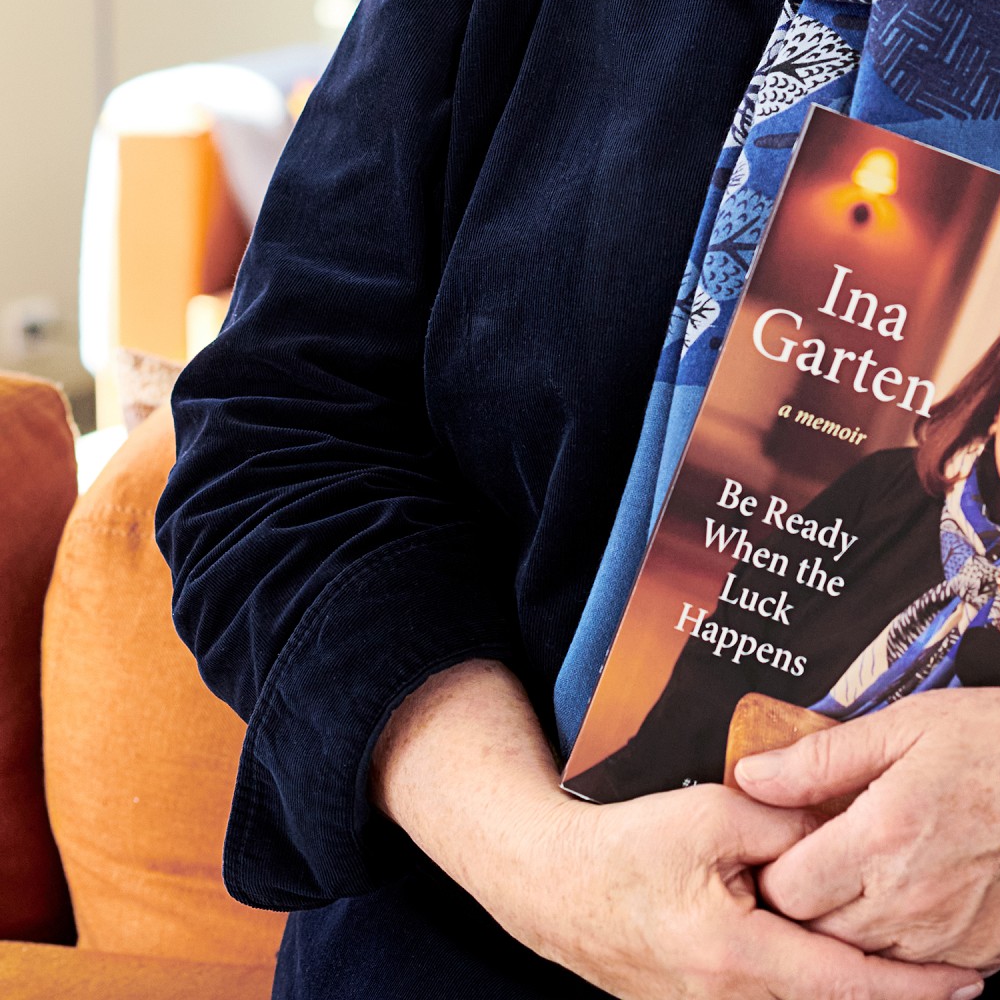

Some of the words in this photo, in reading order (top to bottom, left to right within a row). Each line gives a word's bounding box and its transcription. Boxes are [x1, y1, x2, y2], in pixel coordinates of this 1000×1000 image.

[817, 263, 908, 341] Ina
[752, 308, 936, 418] Garten
[777, 403, 791, 418] a
[794, 411, 868, 445] memoir
[704, 517, 789, 577] When
[795, 557, 846, 597] the
[716, 478, 758, 517] Be
[762, 495, 859, 562] Ready
[718, 572, 795, 625] Luck
[674, 602, 808, 677] Happens
